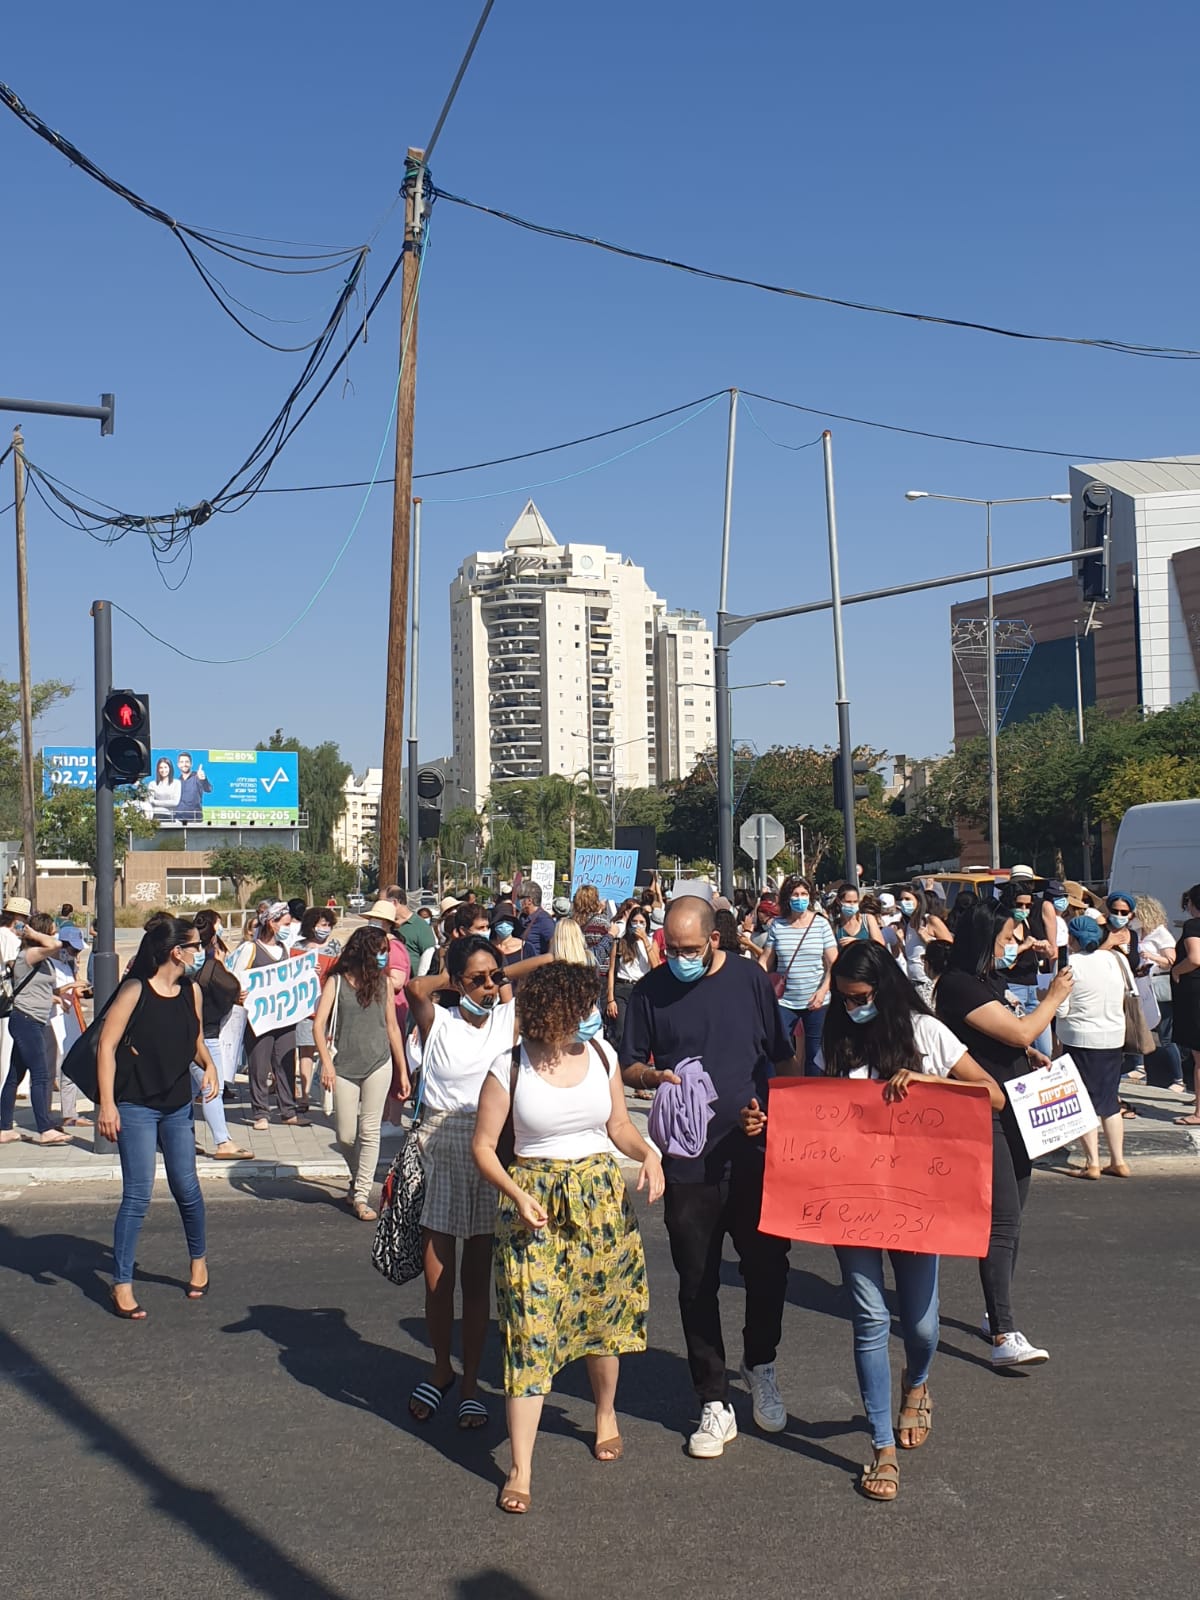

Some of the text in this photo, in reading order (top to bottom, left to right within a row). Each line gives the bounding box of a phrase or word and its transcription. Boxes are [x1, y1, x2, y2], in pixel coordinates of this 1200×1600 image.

[53, 755, 88, 767] פתוח
[51, 770, 96, 785] 02.7.
[210, 810, 290, 820] 1-800-206-205
[247, 952, 316, 993] העוסיות
[251, 976, 318, 1025] נחנקות
[1030, 1096, 1080, 1127] נחנקות!
[871, 1155, 901, 1168] עם
[927, 1156, 951, 1176] של
[802, 1200, 935, 1233] וזה ממש לא
